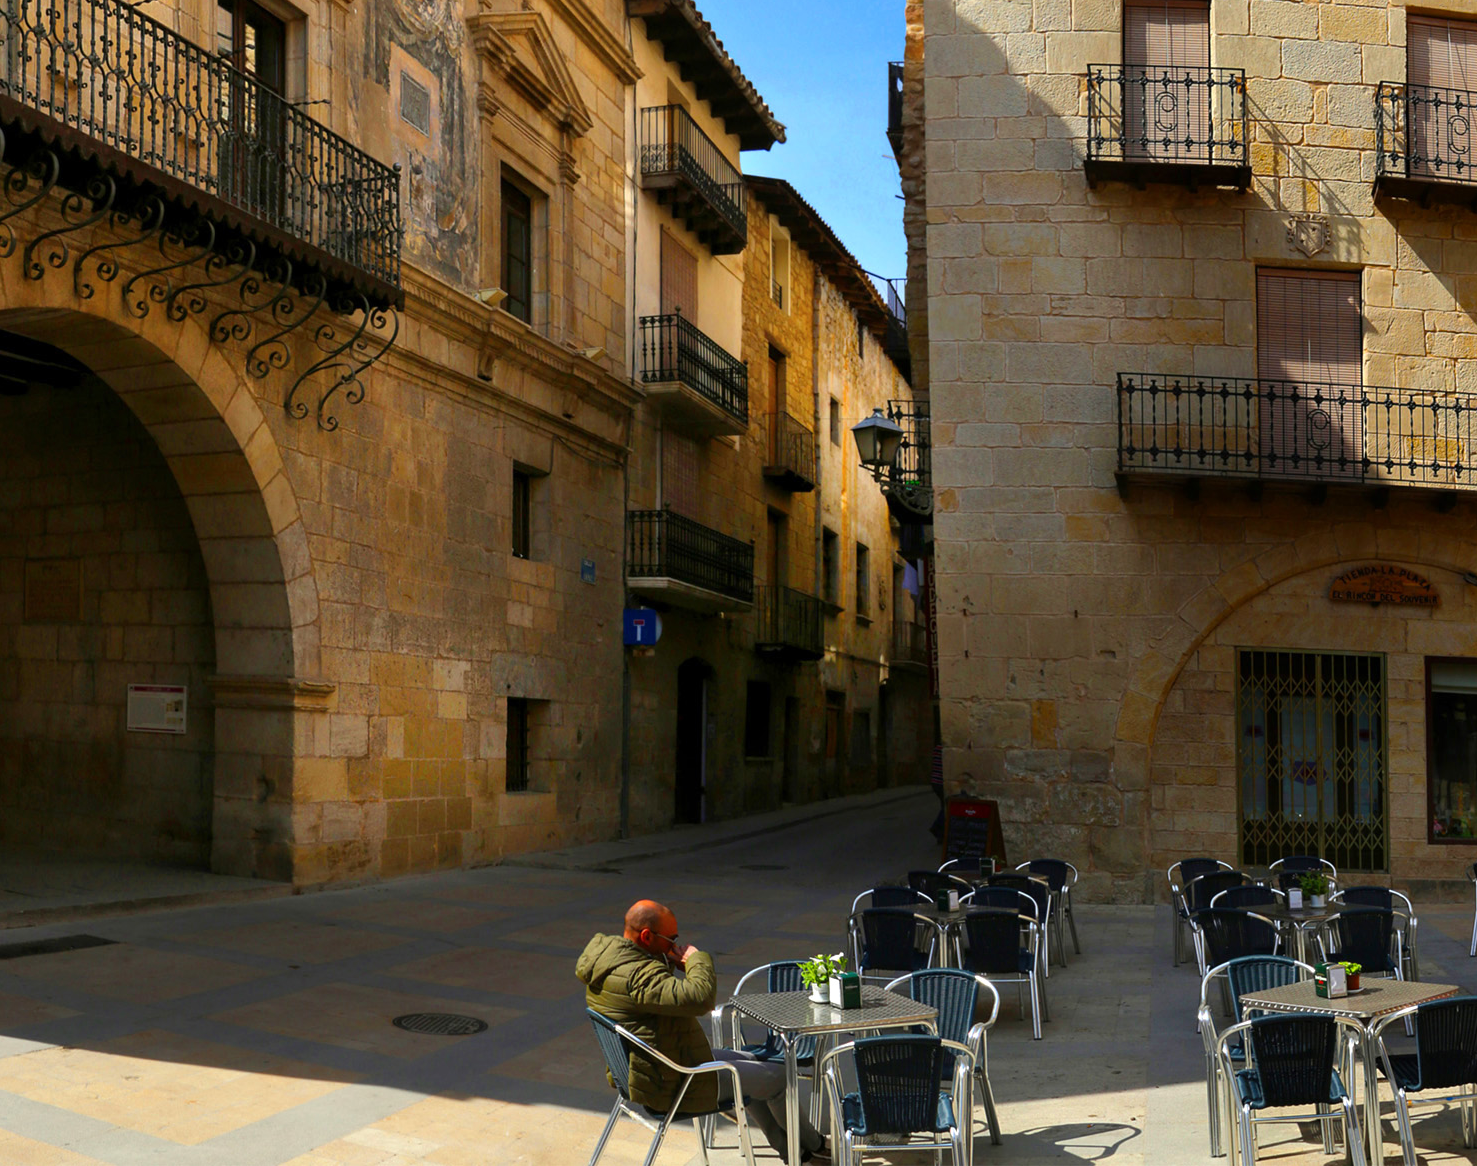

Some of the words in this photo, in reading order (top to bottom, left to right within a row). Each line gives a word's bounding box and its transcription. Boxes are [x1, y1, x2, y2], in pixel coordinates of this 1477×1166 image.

[1338, 566, 1377, 585] TIENDA
[1381, 565, 1395, 575] LA
[1399, 568, 1432, 591] PLAZA
[1332, 591, 1343, 599] EL
[1380, 593, 1394, 602] DEL
[1399, 594, 1438, 604] SOUVENIR
